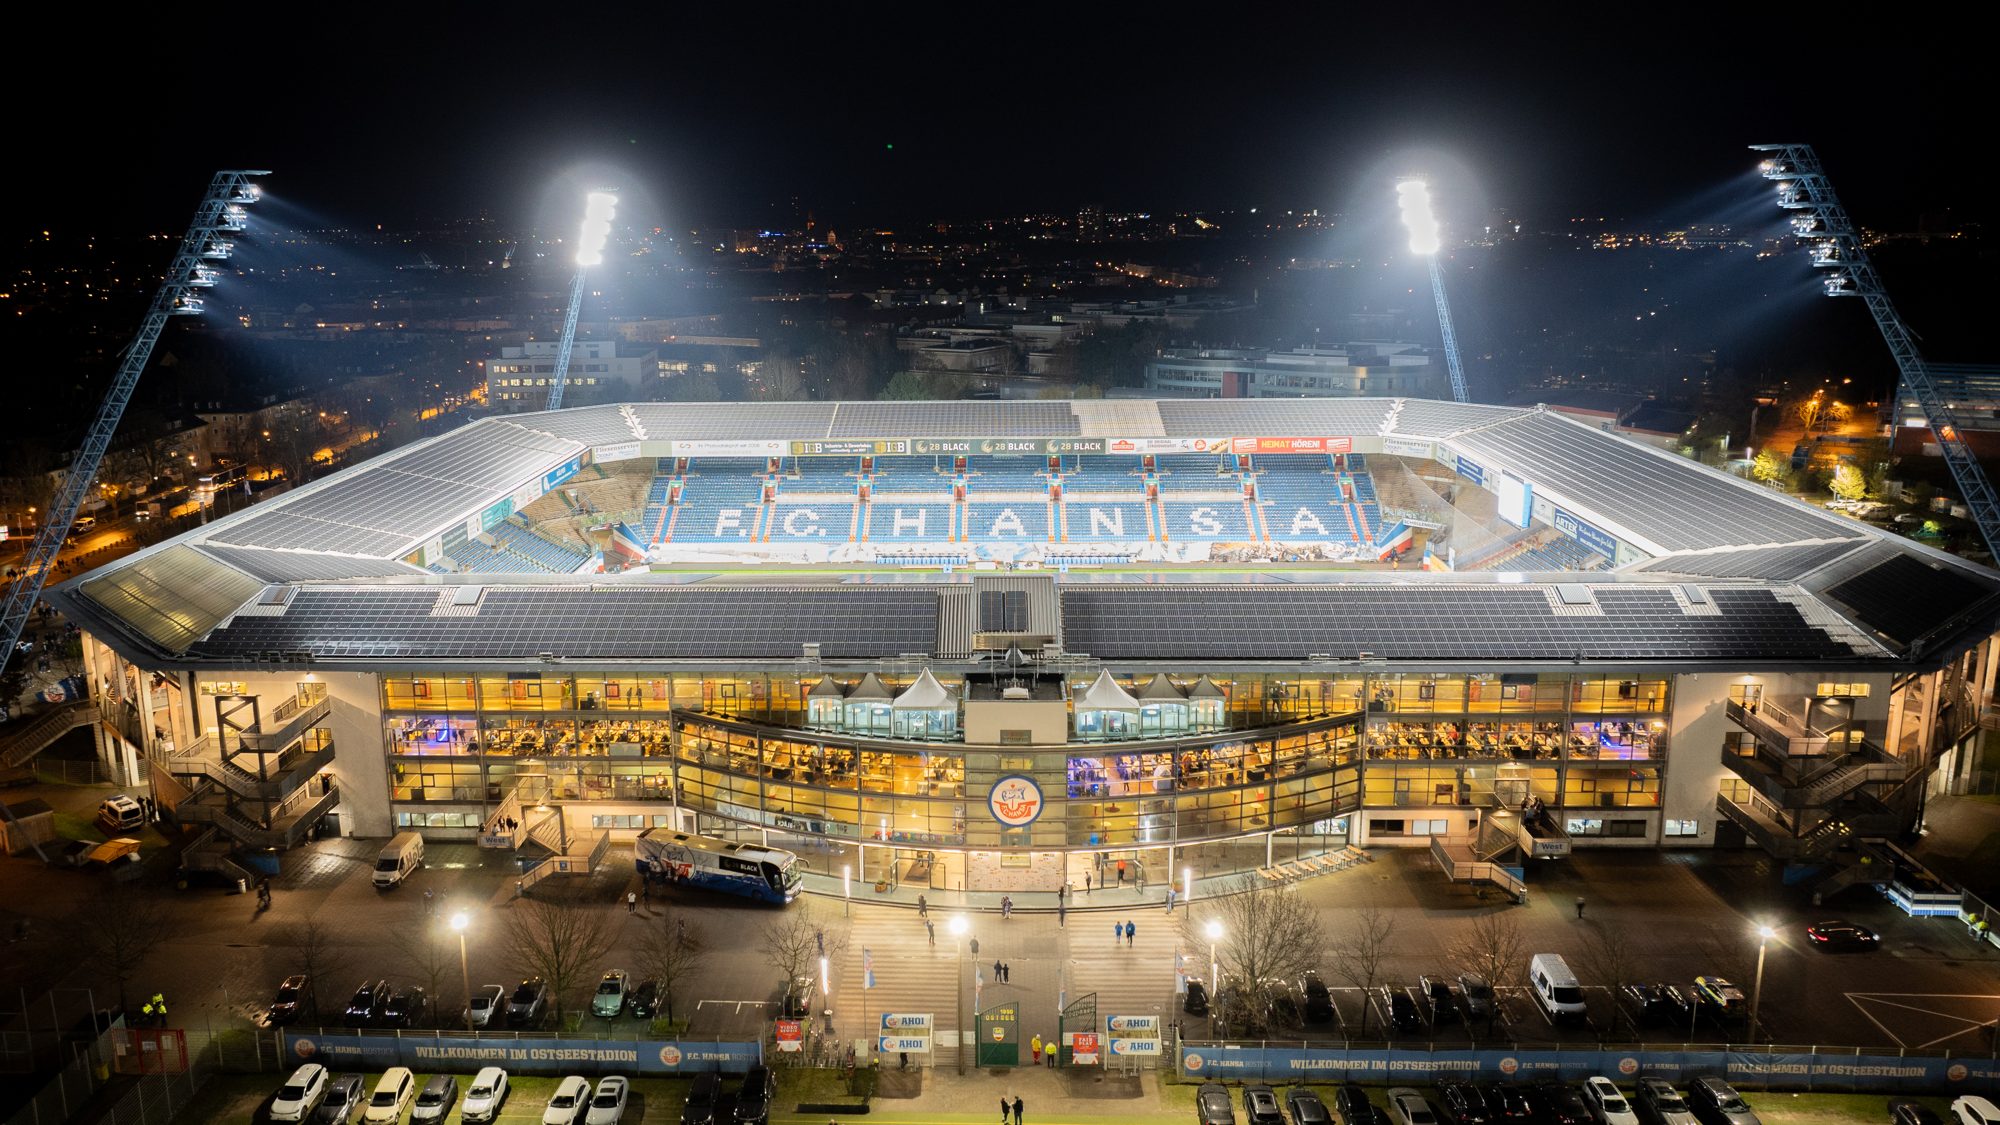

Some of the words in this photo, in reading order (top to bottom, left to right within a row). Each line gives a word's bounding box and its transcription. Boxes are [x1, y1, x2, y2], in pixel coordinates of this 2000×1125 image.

[804, 442, 822, 453] IGB
[886, 441, 905, 452] IGB
[929, 443, 940, 451] 28
[942, 443, 970, 451] BLACK
[995, 443, 1005, 451] 28
[1008, 442, 1035, 451] BLACK
[1060, 442, 1072, 450] 28
[1073, 442, 1101, 450] BLACK
[1261, 440, 1290, 449] HEIMAT
[1291, 438, 1320, 449] HÖREN!
[740, 863, 758, 872] BLACK
[901, 1017, 925, 1025] AHOI
[1126, 1019, 1150, 1028] AHOI
[899, 1040, 923, 1048] AHOI
[1130, 1042, 1154, 1050] AHOI
[335, 1046, 362, 1055] HANSA
[415, 1046, 507, 1060] WILLKOMMEN
[510, 1048, 528, 1060] IM
[530, 1049, 638, 1062] OSTSEESTADION
[687, 1052, 701, 1060] F.C.
[702, 1052, 730, 1061] HANSA
[1220, 1059, 1244, 1067] HANSA
[1289, 1059, 1369, 1070] WILLKOMMEN
[1371, 1059, 1386, 1071] IM
[1389, 1060, 1481, 1071] OSTSEESTADION
[1535, 1062, 1559, 1070] HANSA
[1654, 1063, 1679, 1071] HANSA
[1727, 1063, 1808, 1074] WILLKOMMEN
[1811, 1064, 1826, 1075] IM
[1829, 1065, 1926, 1077] OSTSEESTADION
